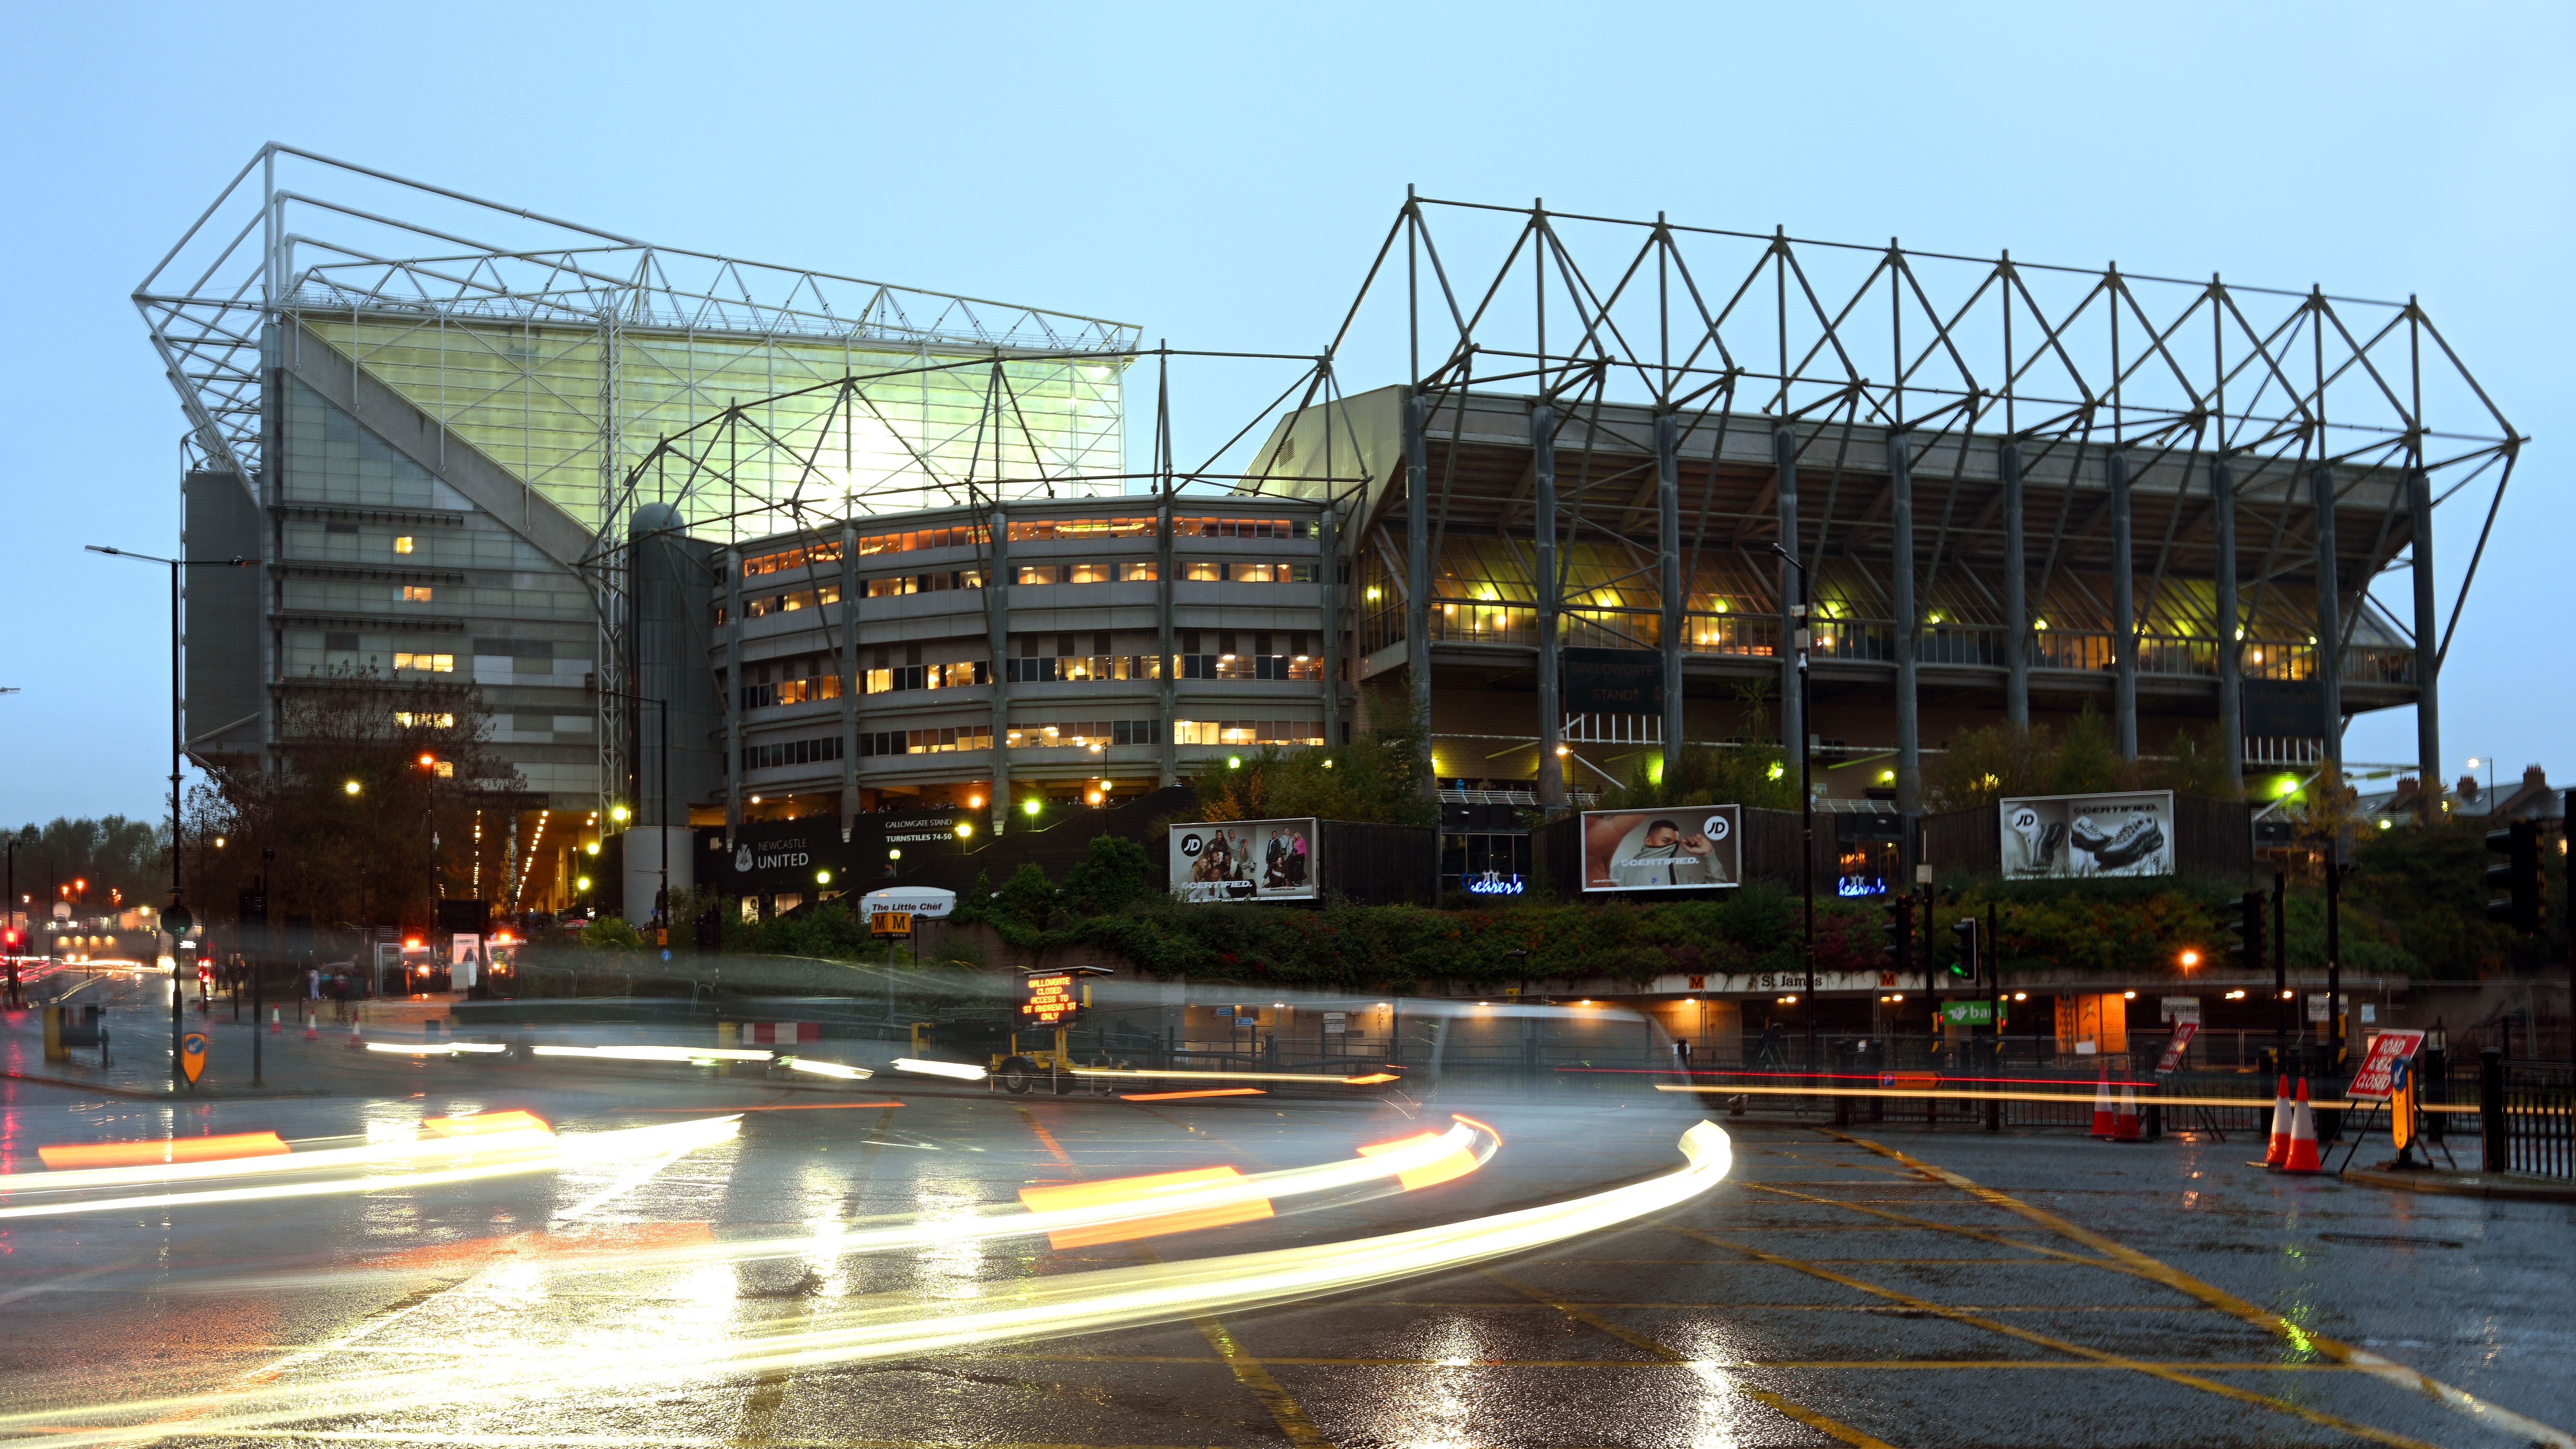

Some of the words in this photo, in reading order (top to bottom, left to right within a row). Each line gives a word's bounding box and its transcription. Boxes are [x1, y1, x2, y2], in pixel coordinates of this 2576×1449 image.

[1571, 661, 1655, 677] GALLOWGATE
[1592, 689, 1632, 701] STAND
[885, 820, 928, 829] GALLOWGATE
[2016, 814, 2034, 827] JD
[1708, 822, 1725, 834] JD
[886, 834, 931, 843] TURNSTILES
[759, 838, 807, 852] NEWCASTLE
[1184, 839, 1201, 851] JD
[758, 852, 809, 870] UNITED
[1629, 857, 1699, 866] CERTIFIED.
[1189, 880, 1253, 889] CERTIFIED.
[875, 916, 885, 929] M
[892, 915, 905, 929] M
[1029, 977, 1070, 988] GALLOWGATE
[1691, 977, 1703, 987] M
[1762, 976, 1776, 988] St
[1781, 975, 1822, 988] Jams
[1882, 974, 1894, 985] M
[1037, 986, 1062, 996] CLOSED
[1030, 995, 1056, 1004] ACCESS
[1023, 1005, 1032, 1014] ST
[1035, 1003, 1065, 1012] ANDREWS
[1041, 1012, 1059, 1020] ONLY
[2377, 1038, 2405, 1055] ROAD
[2366, 1055, 2392, 1072] AHEA
[2356, 1072, 2391, 1091] CLOSED
